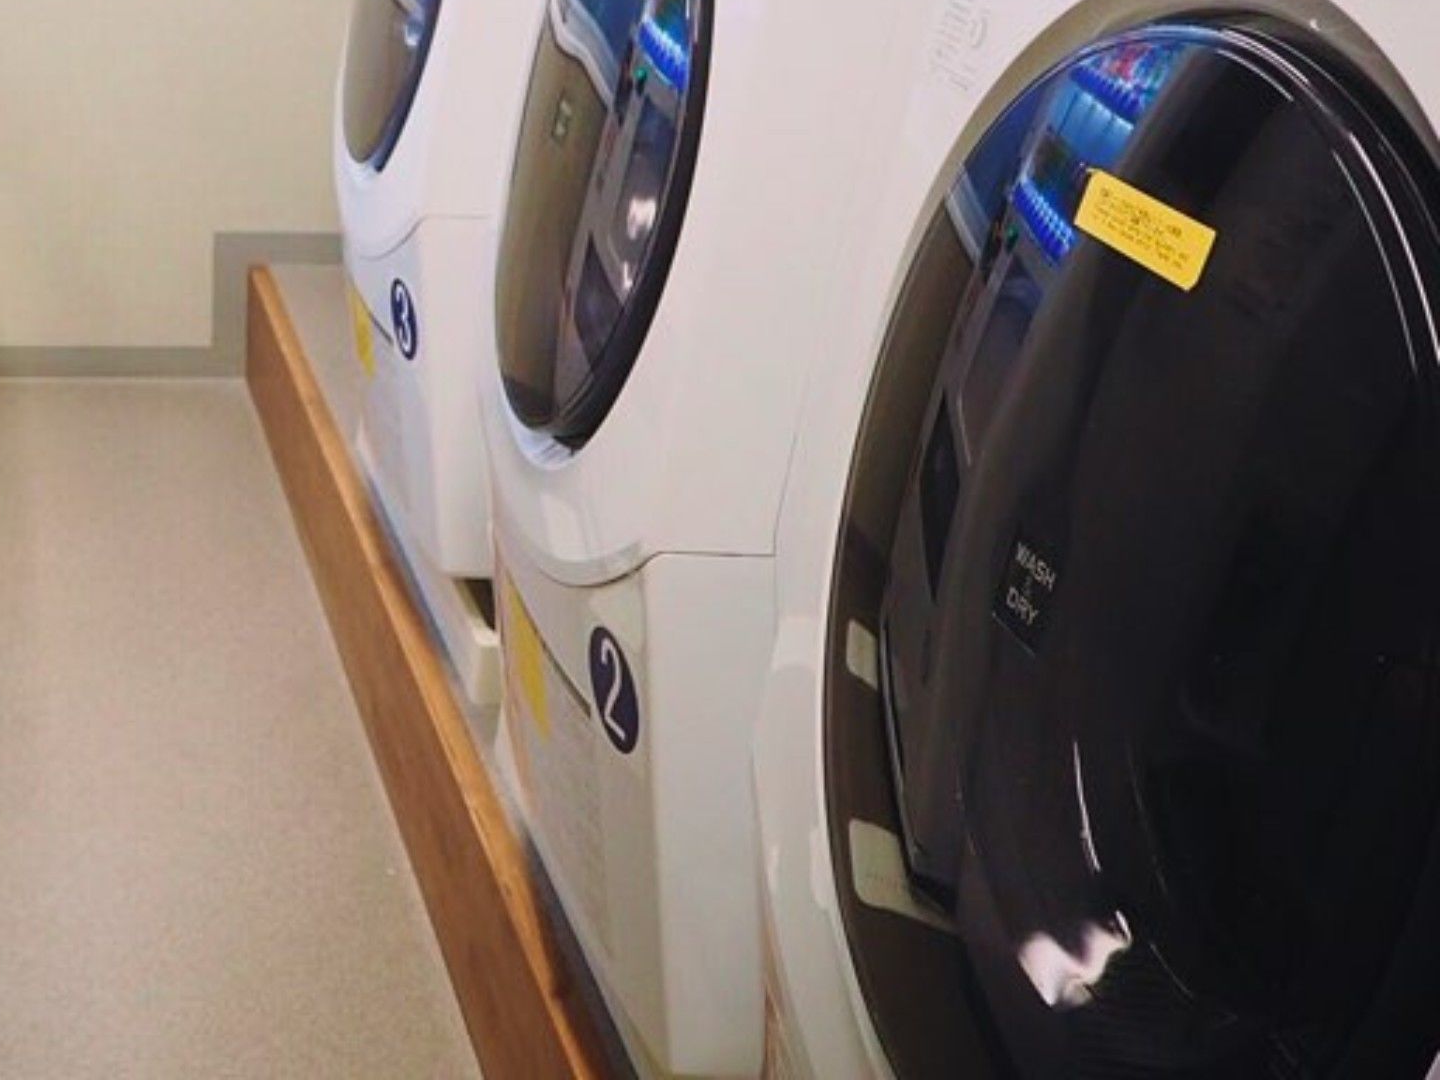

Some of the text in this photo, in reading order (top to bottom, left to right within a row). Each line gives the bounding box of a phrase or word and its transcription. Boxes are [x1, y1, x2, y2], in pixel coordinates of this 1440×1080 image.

[395, 283, 412, 353] 3
[1016, 541, 1057, 592] WASH
[1006, 586, 1039, 627] DRY
[601, 637, 626, 742] 2
